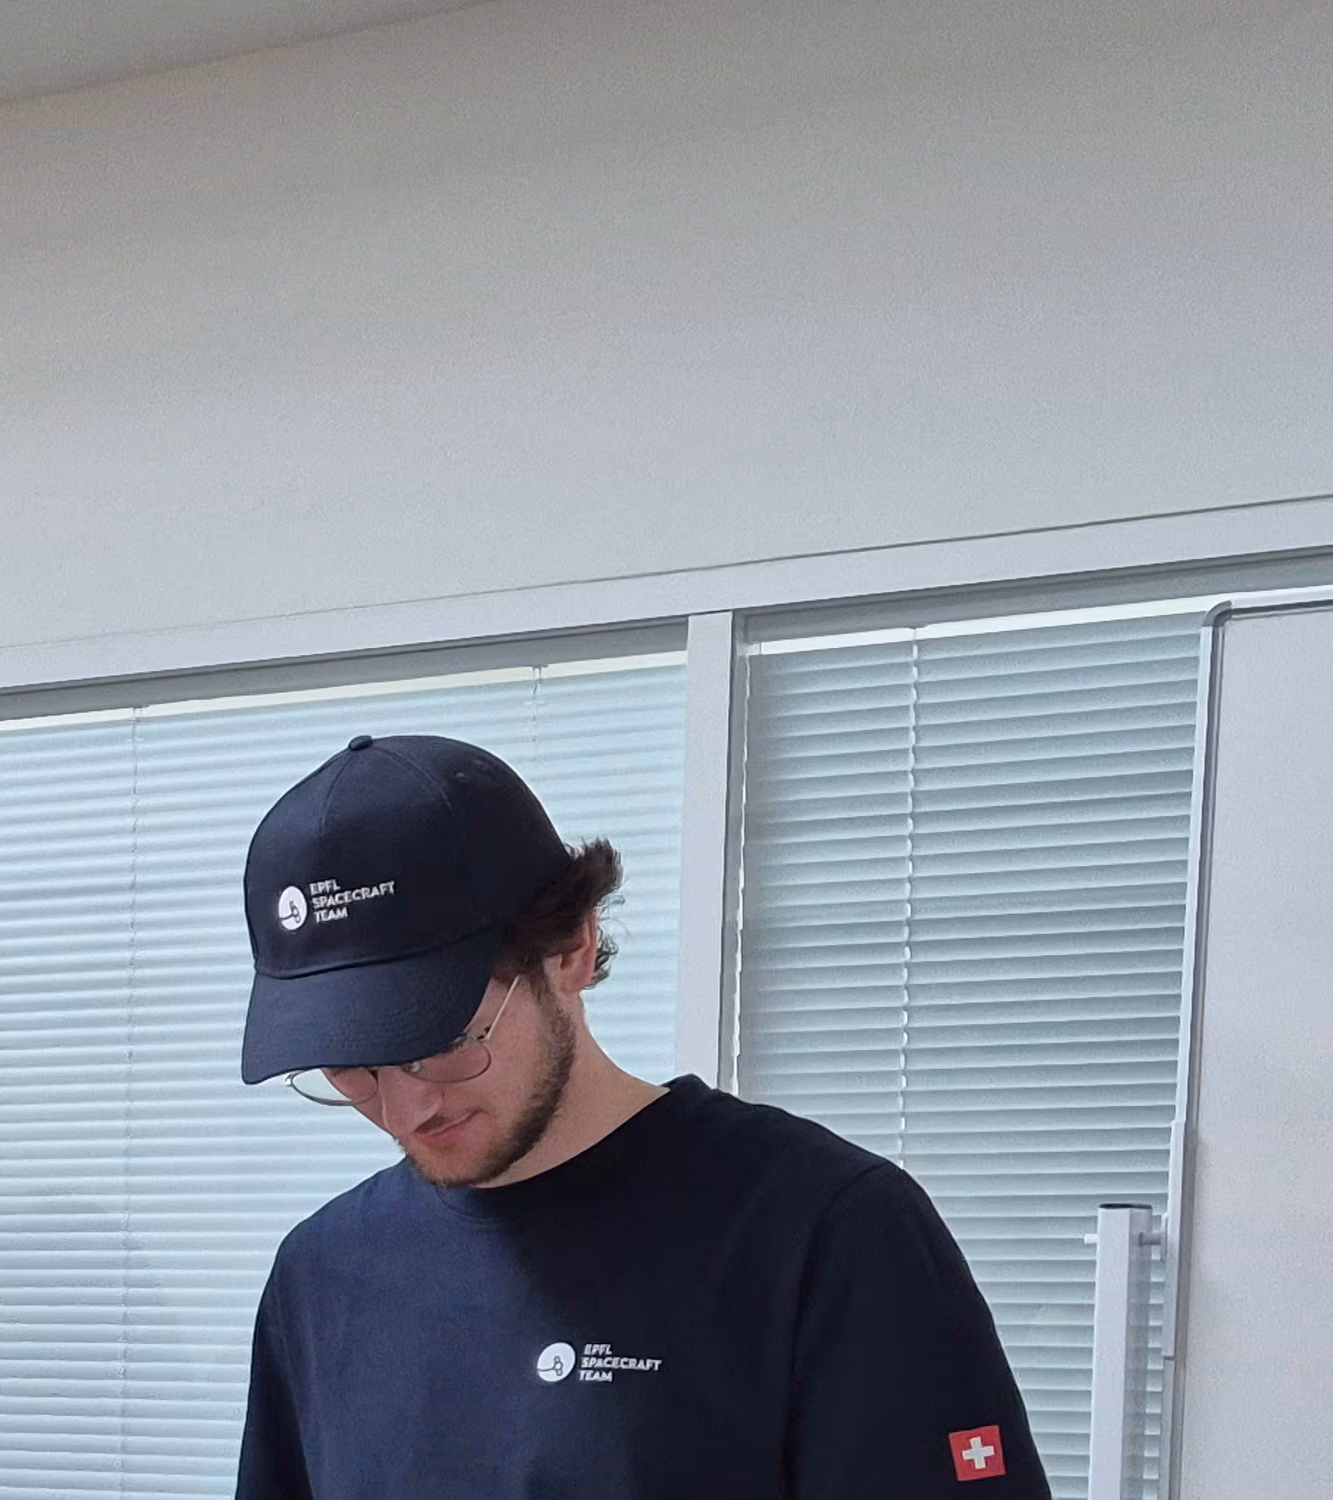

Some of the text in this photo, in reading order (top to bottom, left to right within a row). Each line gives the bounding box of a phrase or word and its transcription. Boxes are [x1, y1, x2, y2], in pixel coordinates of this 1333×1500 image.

[309, 879, 341, 895] EPFL
[312, 881, 395, 909] SPACECRAFT
[314, 907, 348, 923] TEAM
[584, 1344, 612, 1355] EPFL
[581, 1356, 662, 1371] SPACECRAFT
[579, 1370, 613, 1382] TEAM
